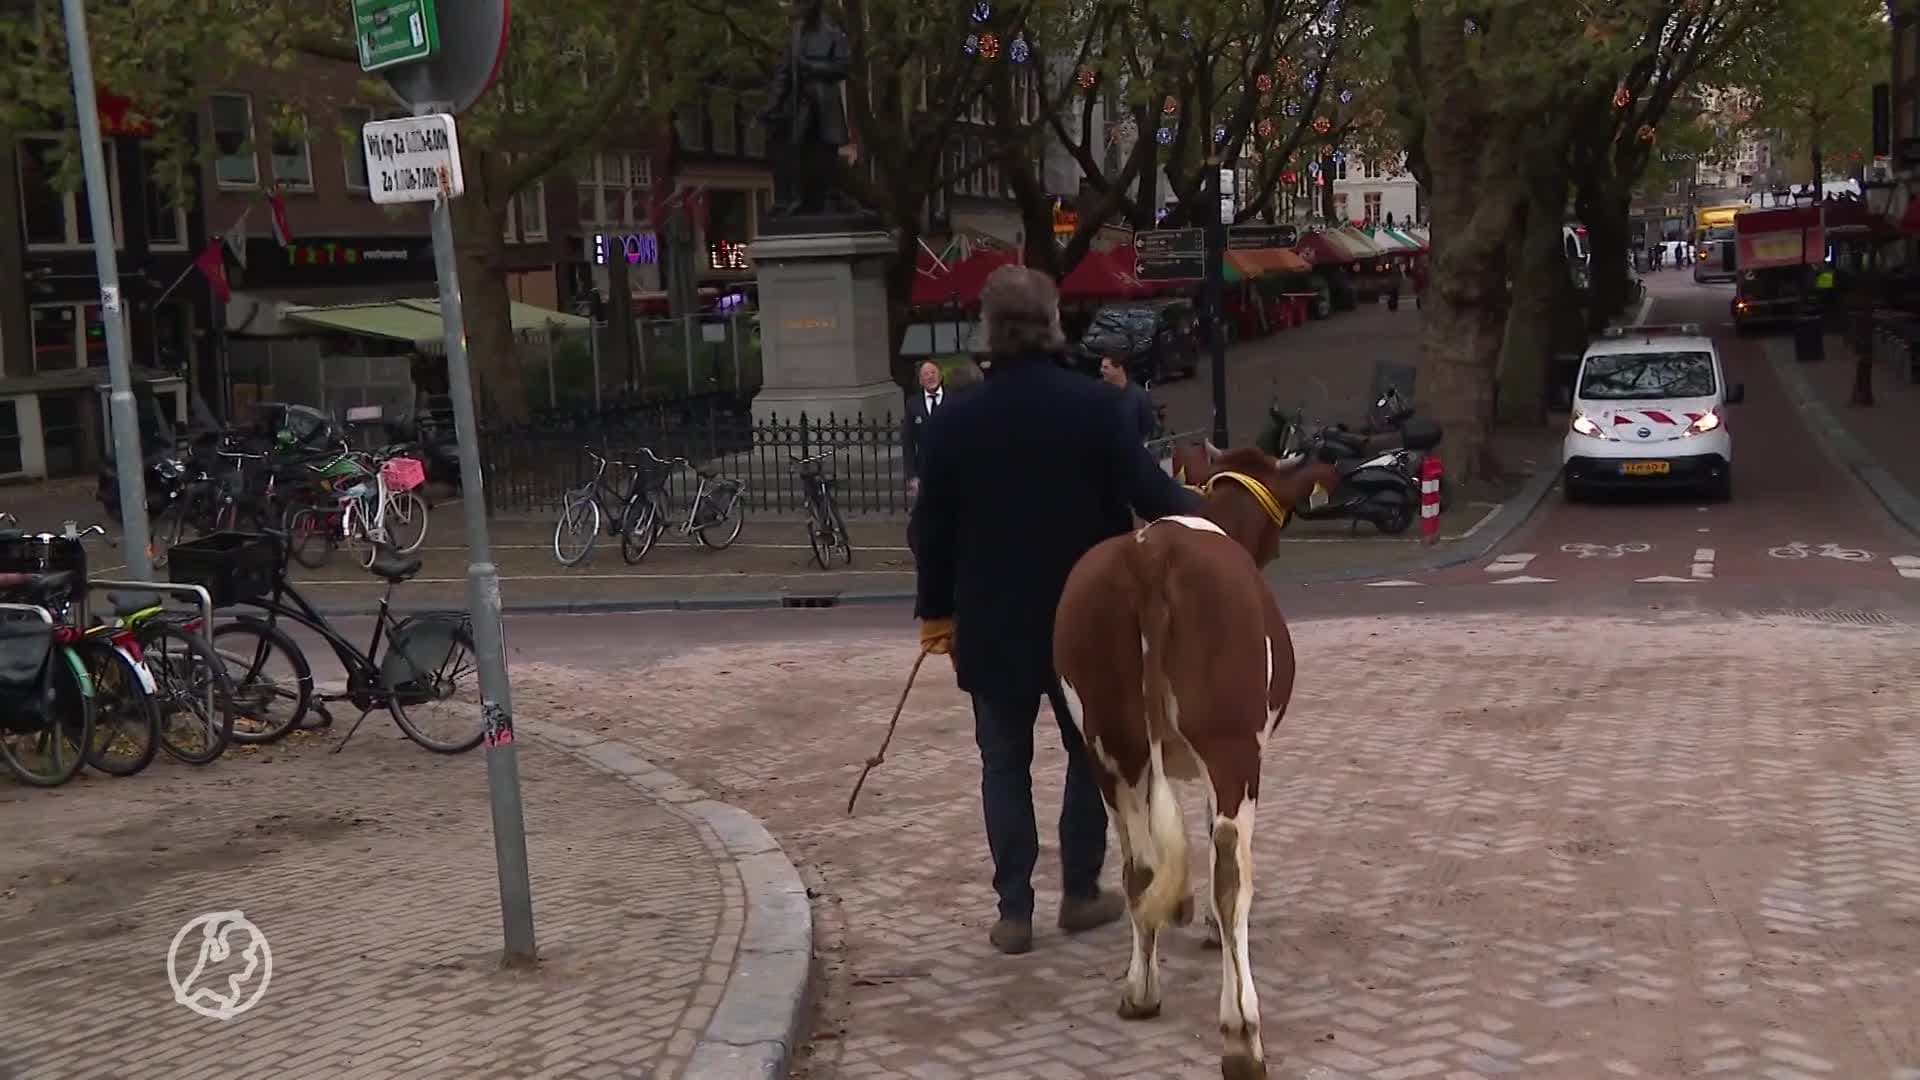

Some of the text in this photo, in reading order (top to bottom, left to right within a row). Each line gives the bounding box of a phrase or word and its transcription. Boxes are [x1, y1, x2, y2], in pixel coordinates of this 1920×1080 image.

[366, 134, 382, 161] Vrij
[394, 133, 405, 154] Za
[382, 171, 393, 192] Zo
